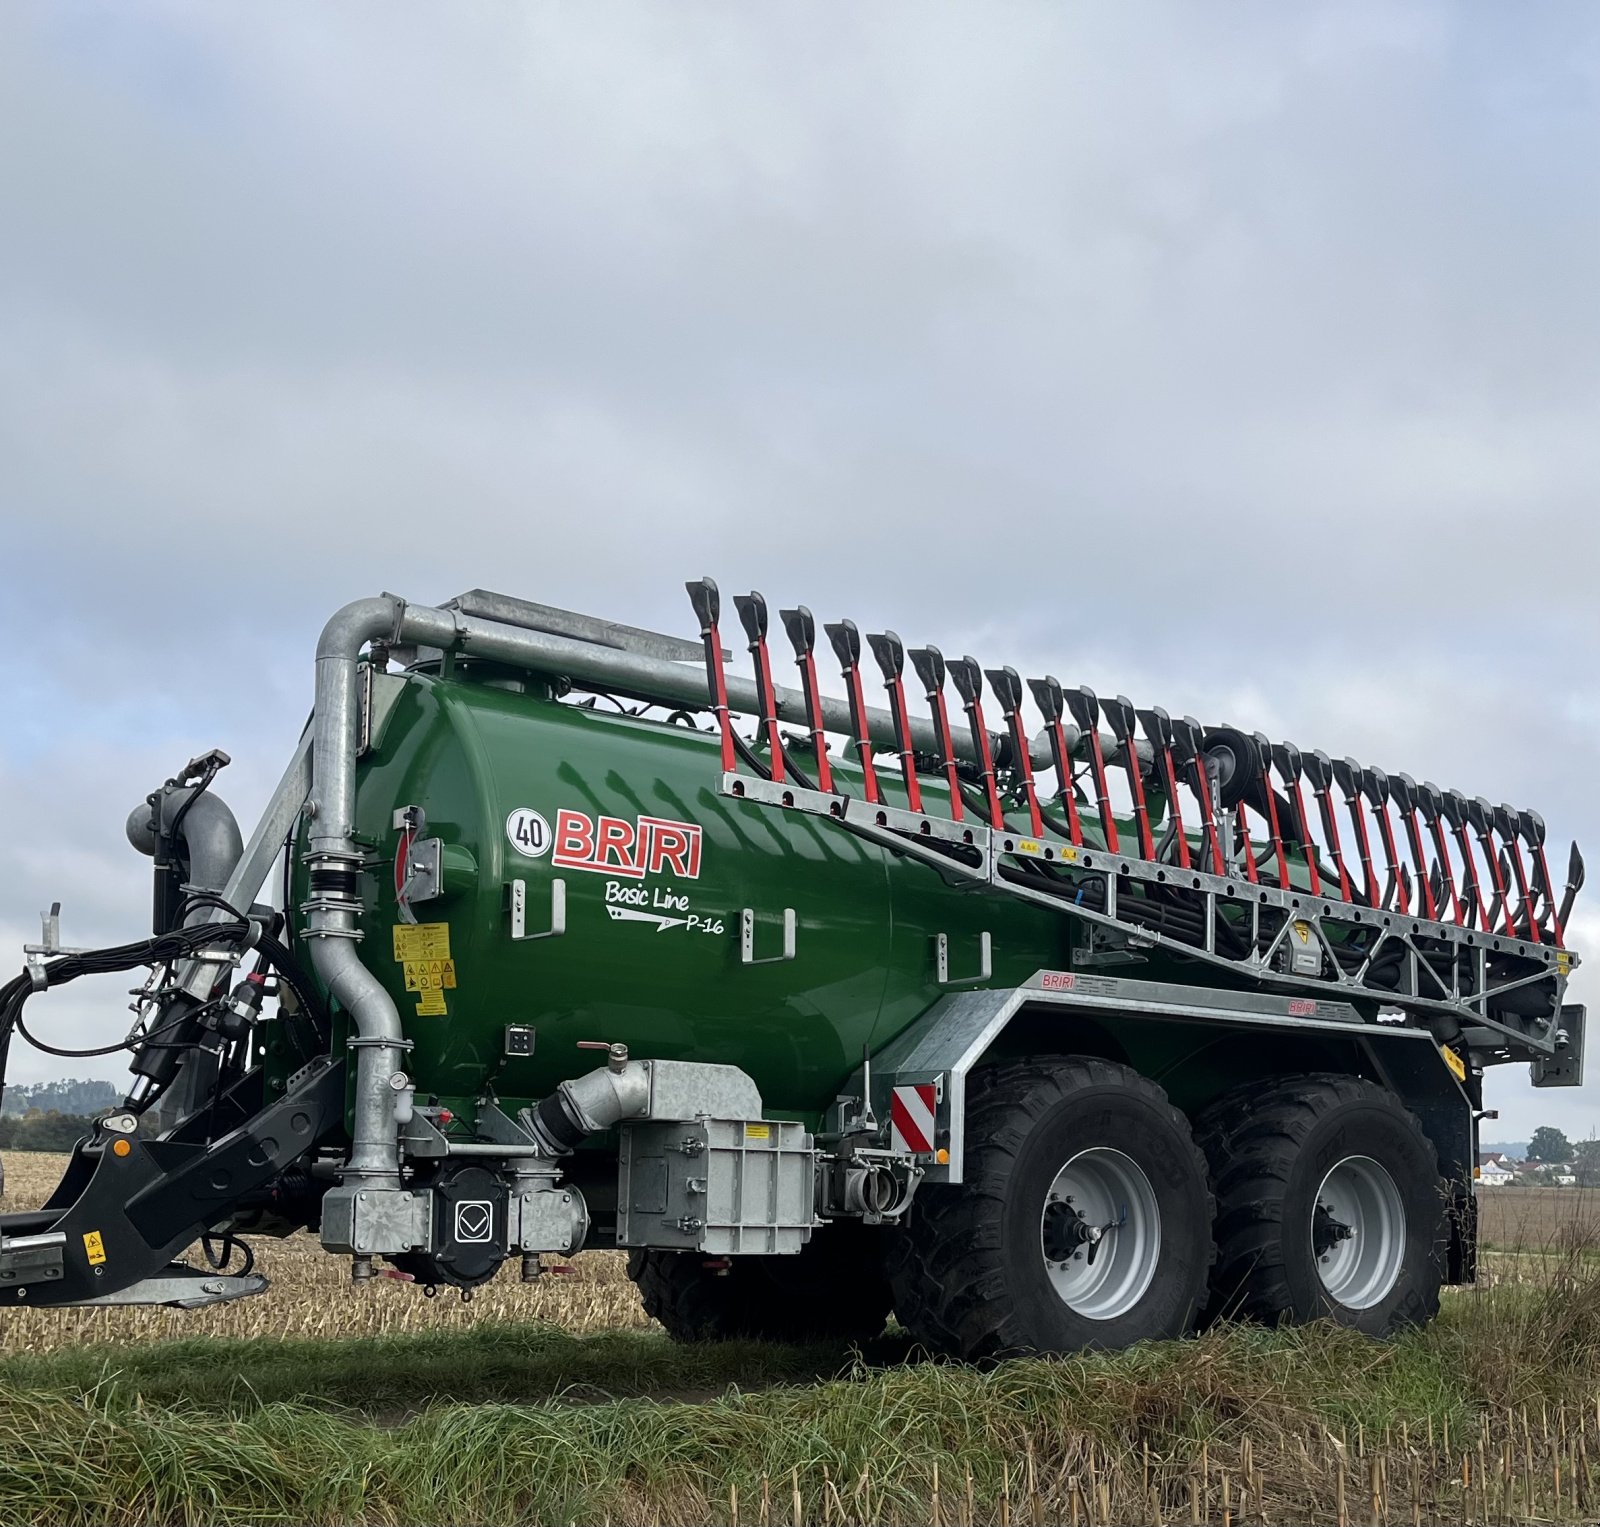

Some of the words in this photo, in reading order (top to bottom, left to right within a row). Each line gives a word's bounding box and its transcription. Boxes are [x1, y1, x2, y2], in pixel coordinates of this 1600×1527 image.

[516, 816, 543, 848] 40
[553, 809, 701, 879] BRIRI
[605, 881, 648, 905] Basic
[653, 887, 689, 911] Line
[686, 915, 724, 934] P-16
[1043, 974, 1074, 990] BRIRI
